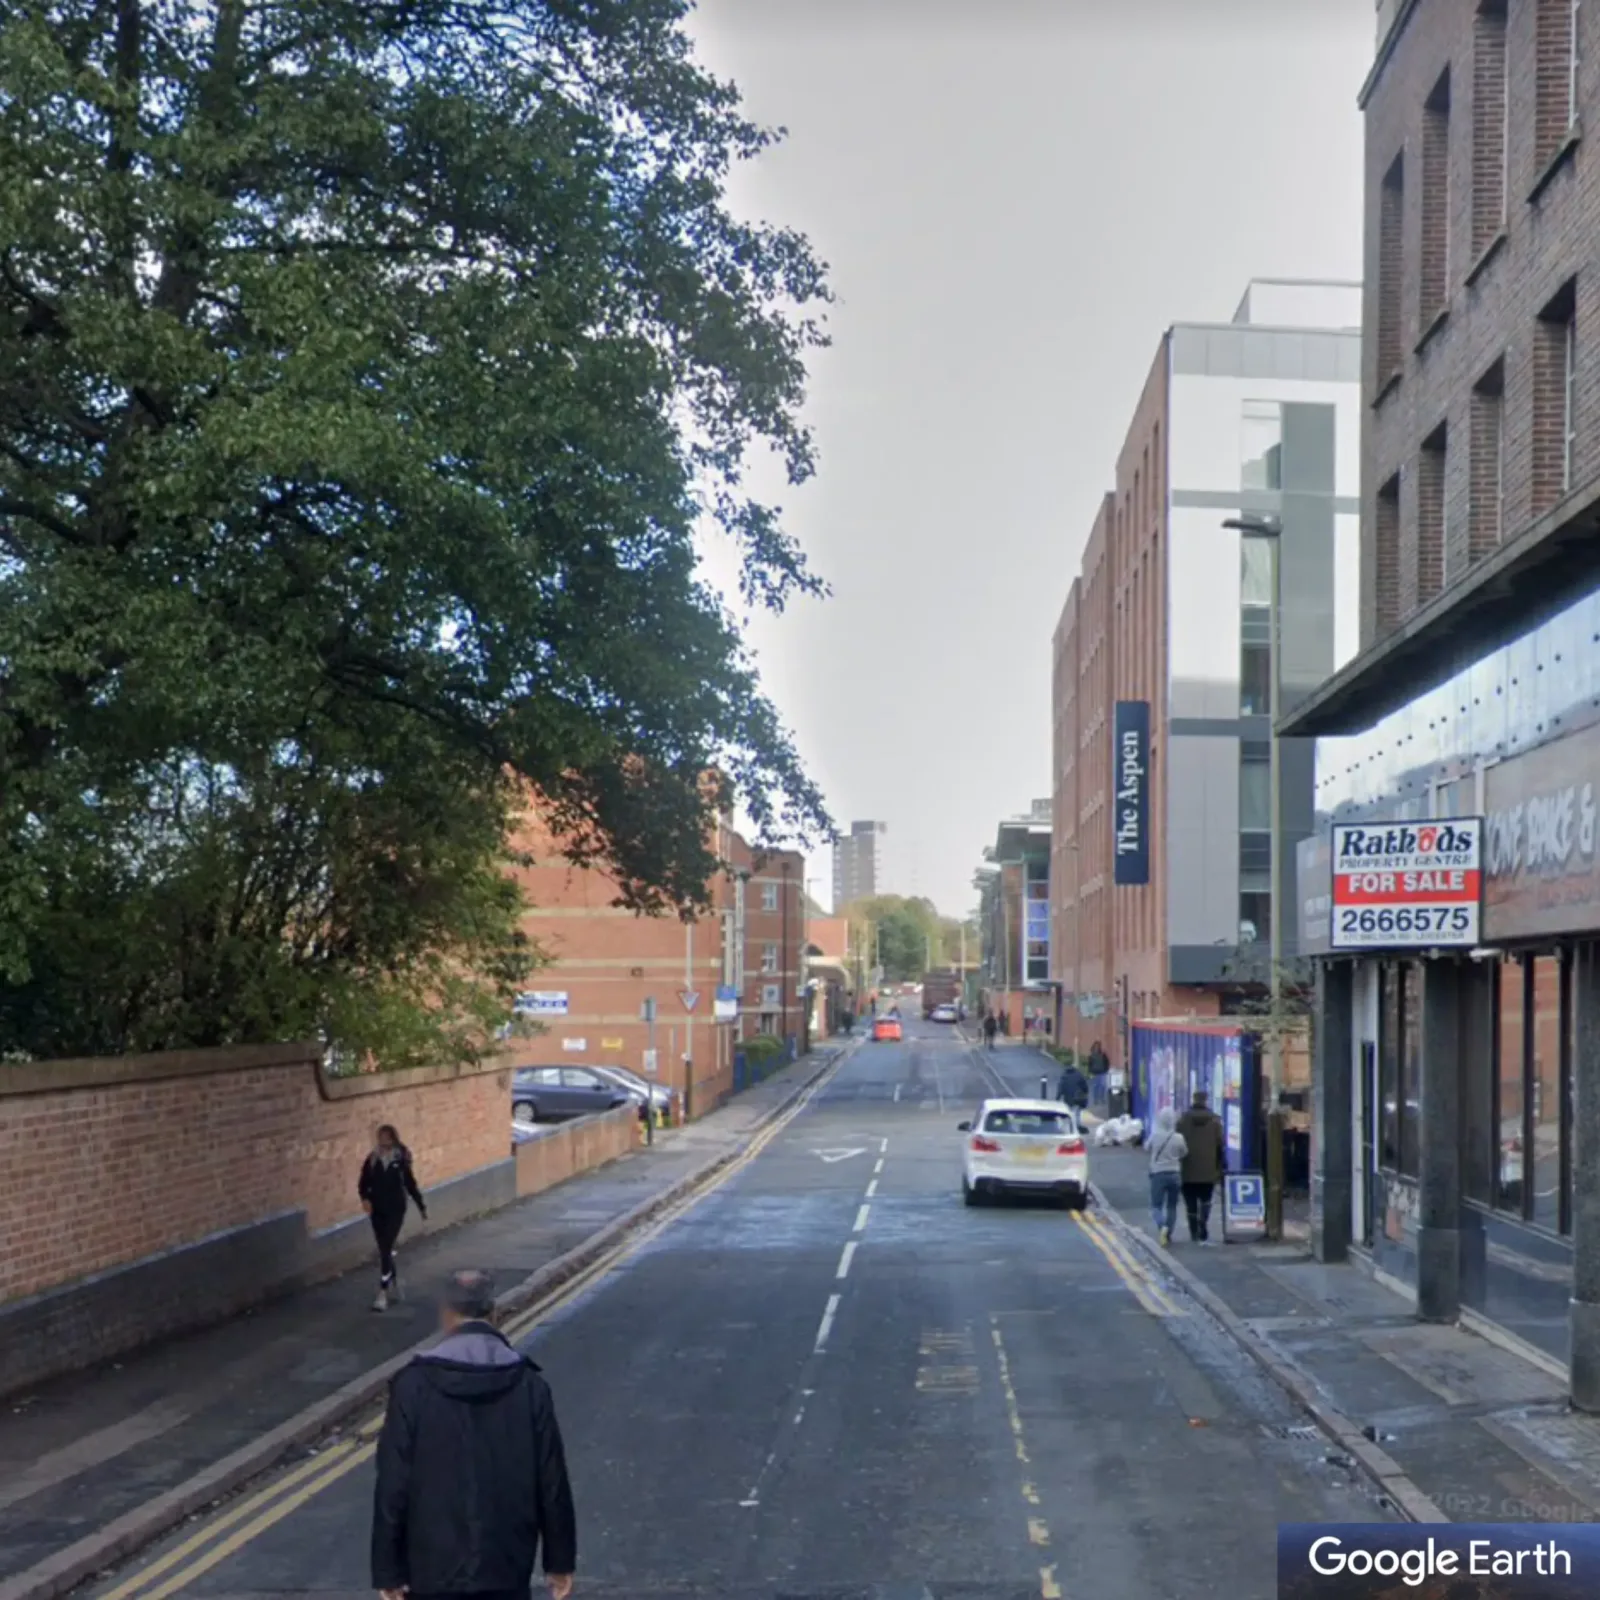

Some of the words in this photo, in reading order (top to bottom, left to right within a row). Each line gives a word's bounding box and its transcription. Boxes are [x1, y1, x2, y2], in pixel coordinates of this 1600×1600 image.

[1117, 730, 1144, 804] Aspen
[1117, 809, 1139, 855] The
[1340, 825, 1472, 856] Rathods
[1340, 856, 1409, 869] PROPERTY
[1415, 854, 1472, 866] CENTRE
[1348, 873, 1396, 893] FOR
[1403, 870, 1465, 892] SALE
[1341, 907, 1470, 933] 2666575
[1236, 1181, 1255, 1203] P
